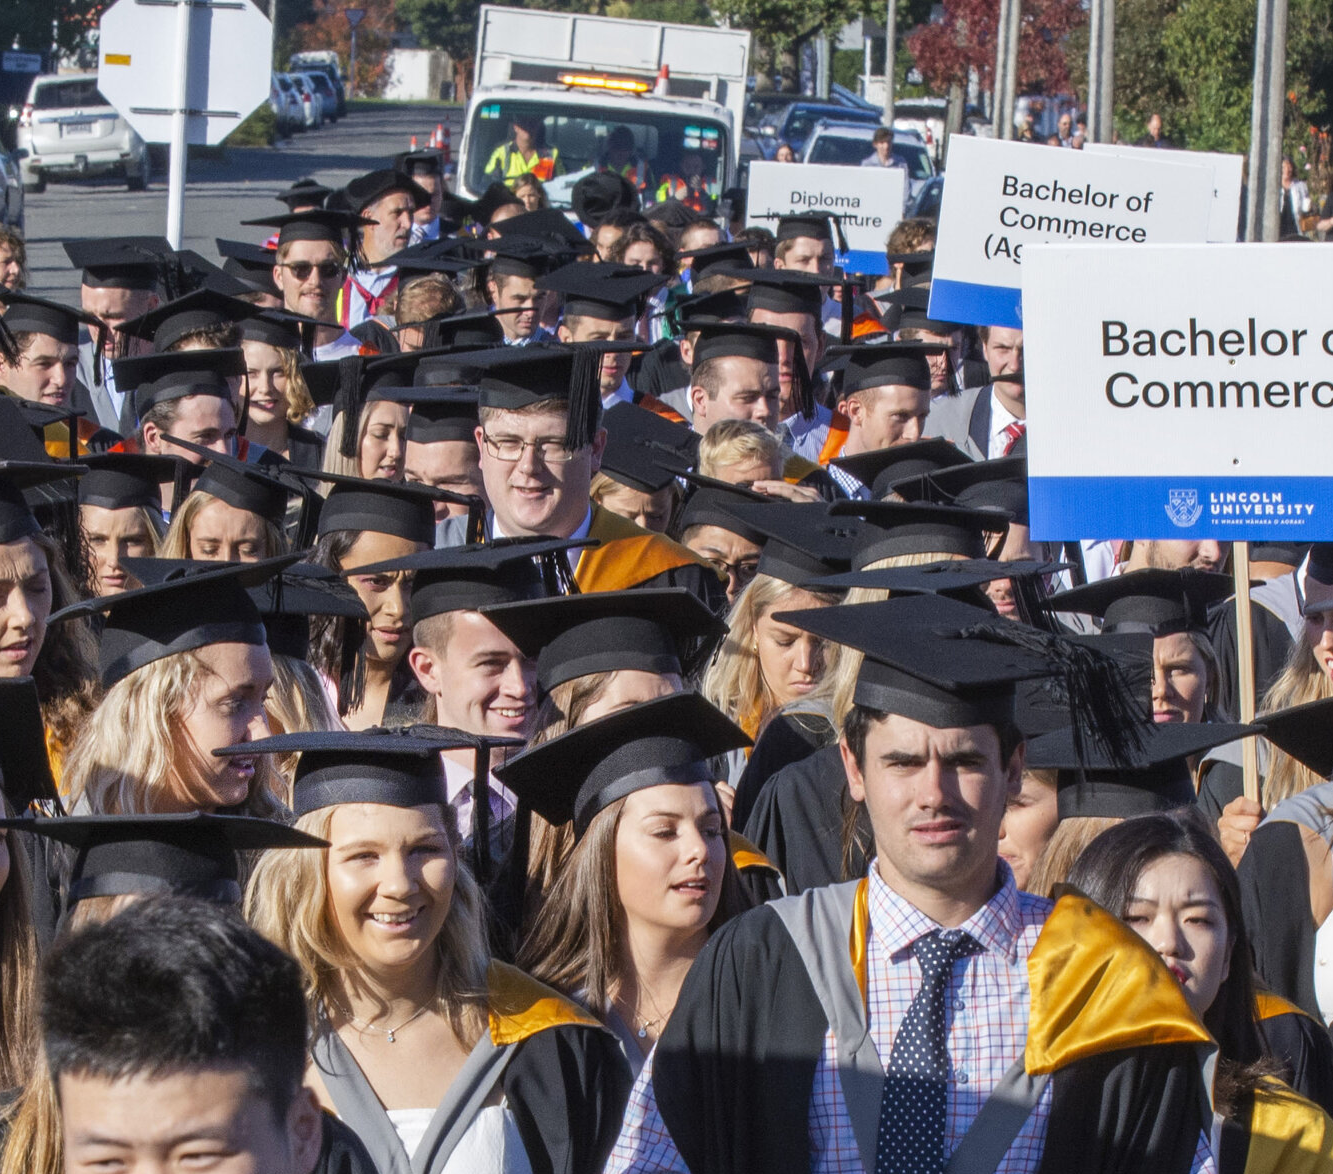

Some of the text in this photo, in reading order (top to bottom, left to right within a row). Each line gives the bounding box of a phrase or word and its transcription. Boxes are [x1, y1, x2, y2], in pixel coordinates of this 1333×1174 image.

[790, 191, 861, 208] Diploma
[1002, 175, 1154, 213] Bachelor of
[999, 206, 1147, 243] Commerce
[1102, 318, 1307, 356] Bachelor
[1210, 492, 1282, 503] LINCOLN
[1210, 504, 1314, 515] UNIVERSITY
